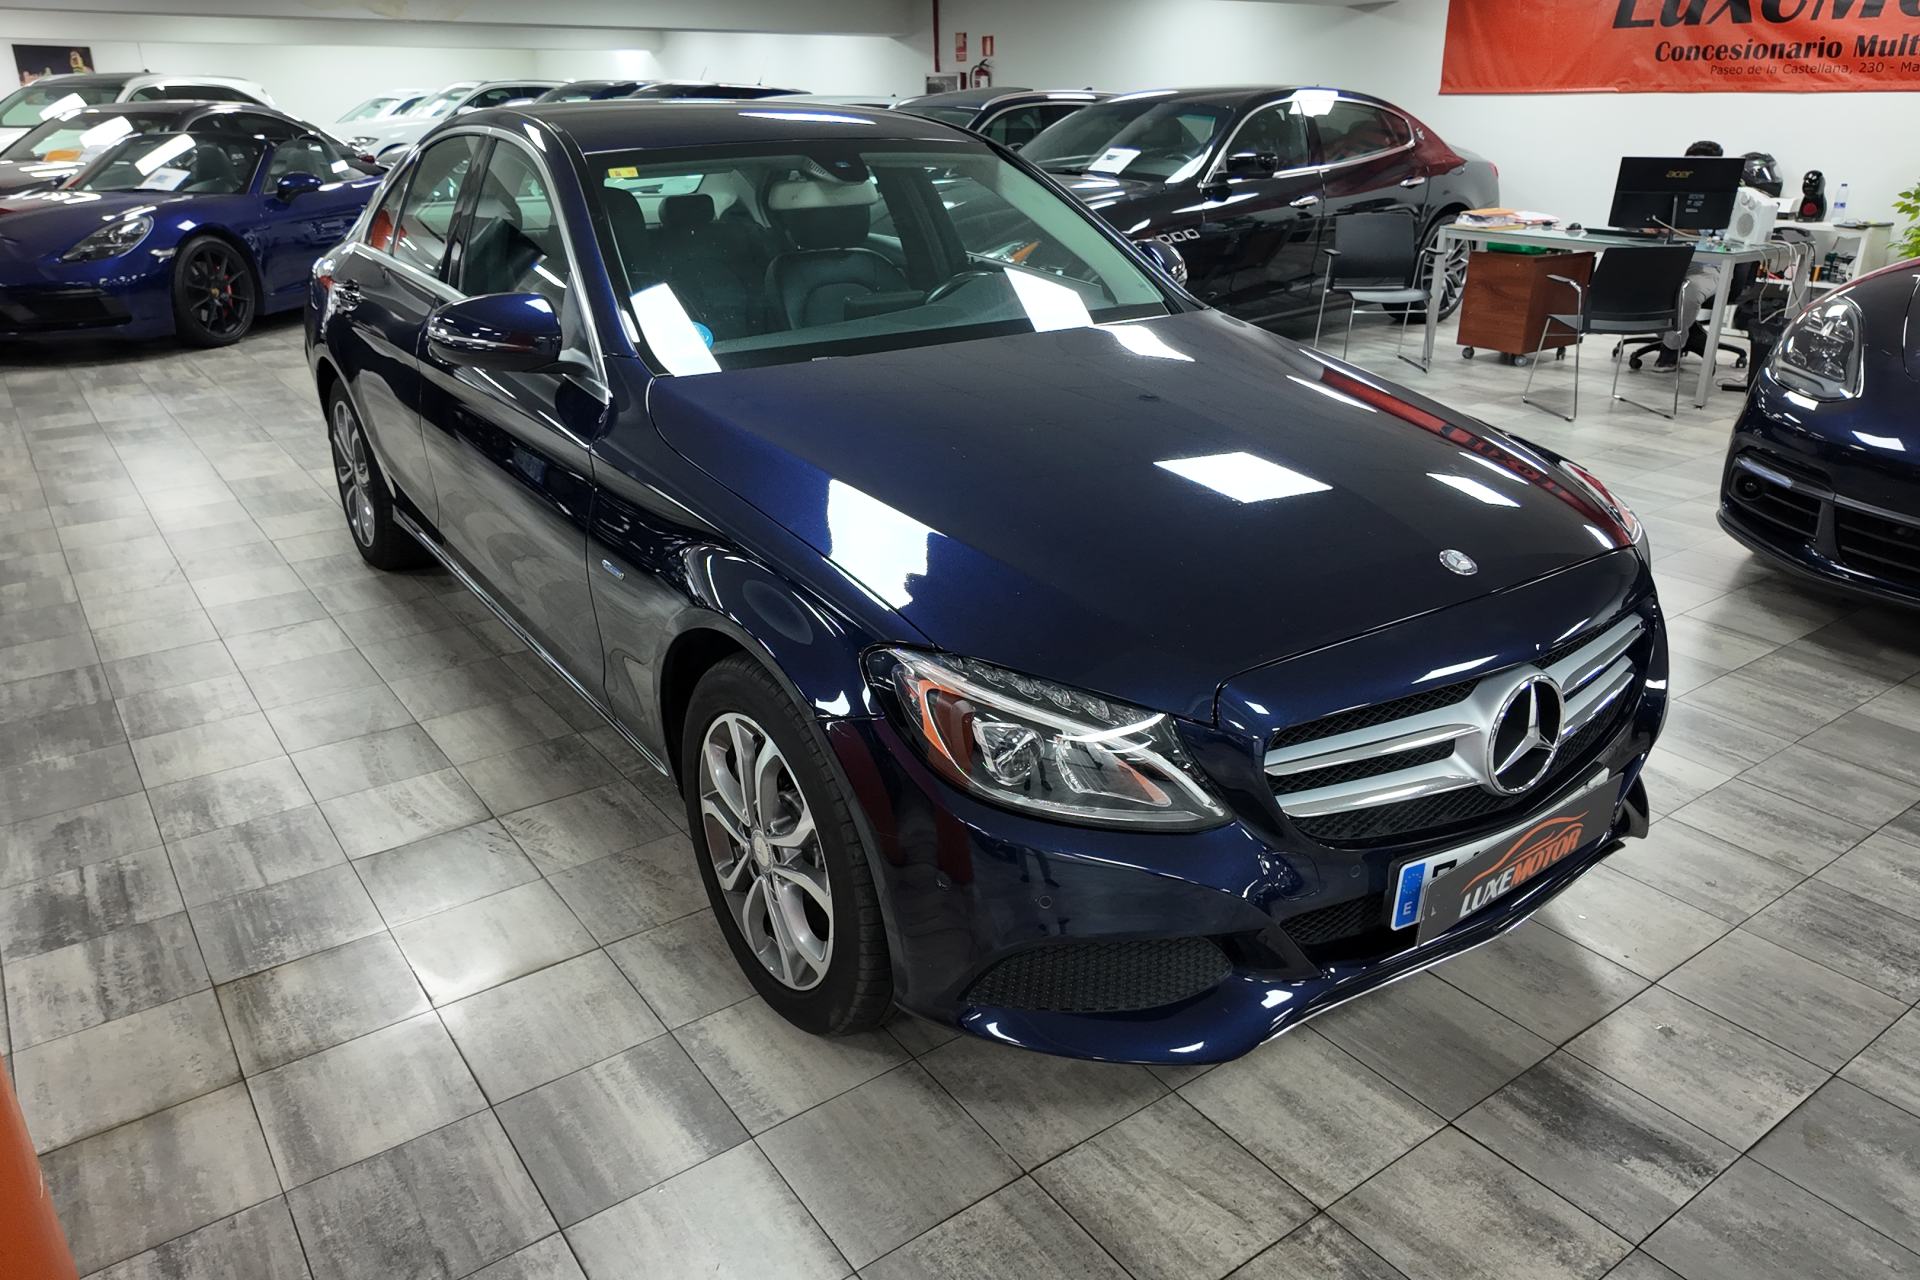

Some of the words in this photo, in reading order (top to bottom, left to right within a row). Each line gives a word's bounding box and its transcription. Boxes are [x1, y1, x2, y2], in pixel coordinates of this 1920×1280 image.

[1655, 36, 1843, 61] Concesionario
[1710, 65, 1743, 75] Paseo
[1747, 64, 1762, 75] de
[1767, 64, 1777, 74] la
[1782, 63, 1853, 74] Castellana,
[1858, 62, 1884, 73] 230
[1403, 901, 1412, 915] E
